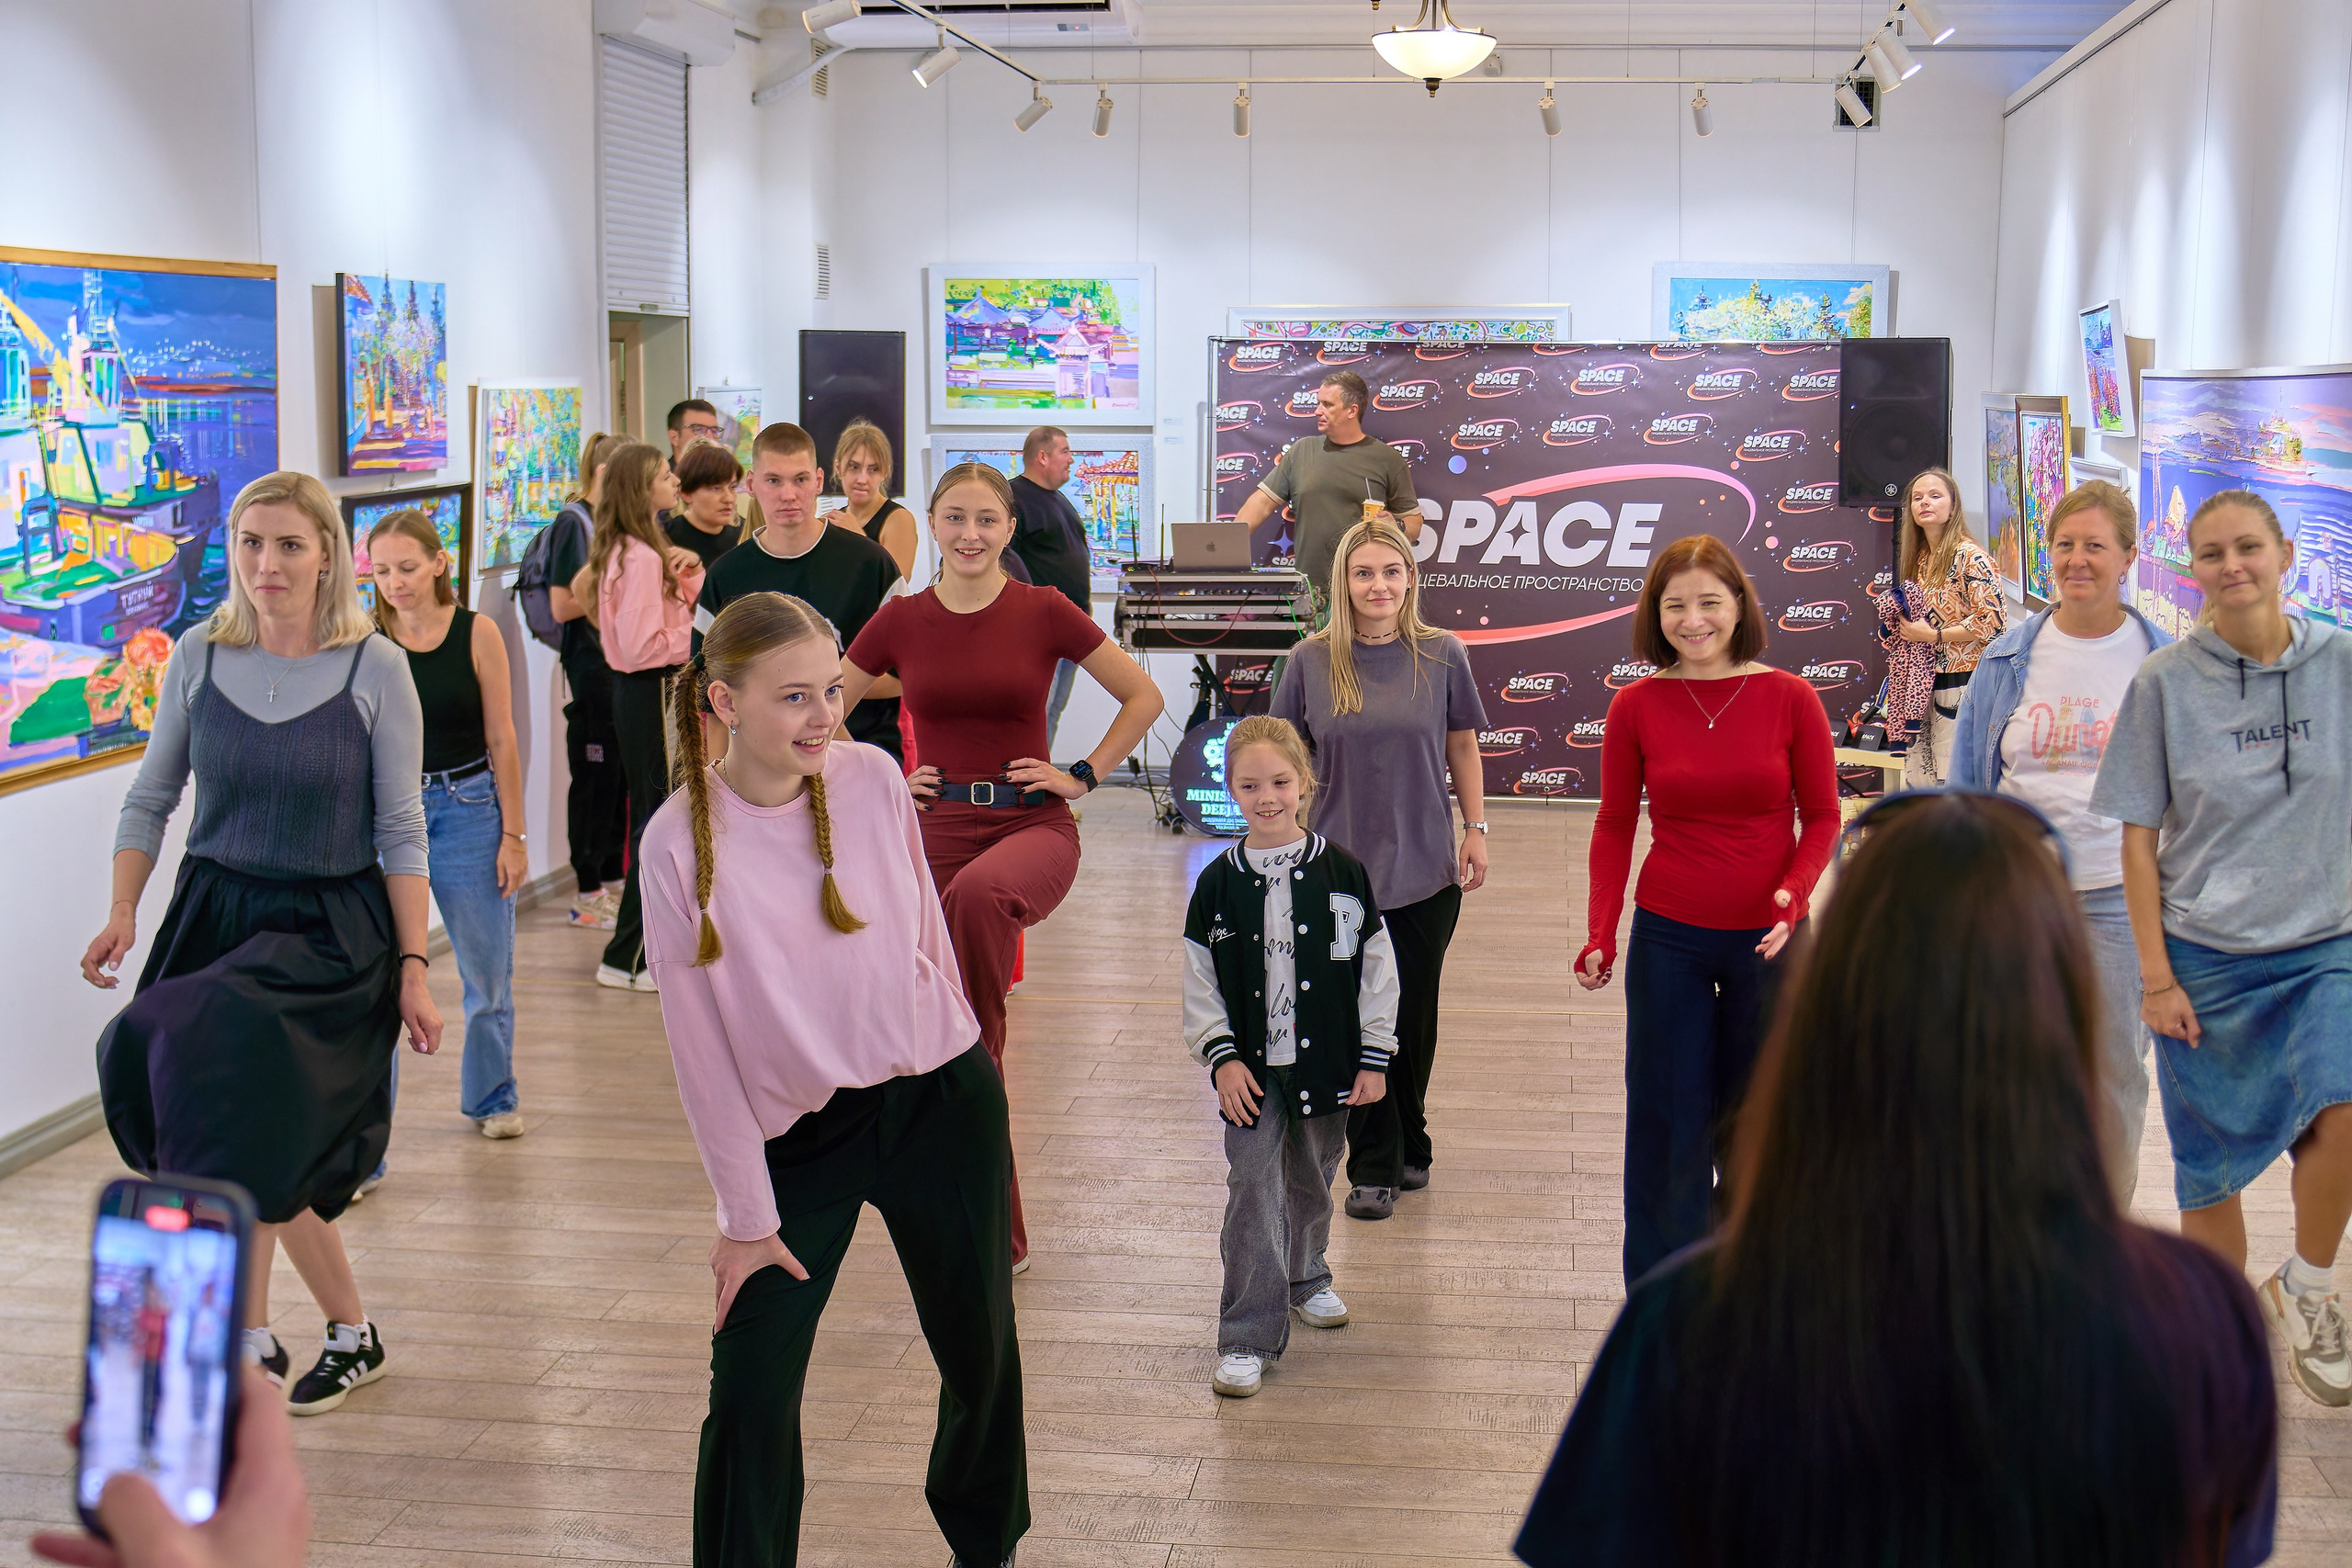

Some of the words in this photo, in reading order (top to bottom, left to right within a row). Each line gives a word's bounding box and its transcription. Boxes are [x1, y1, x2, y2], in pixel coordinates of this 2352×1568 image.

[1236, 345, 1282, 358] SPACE
[1474, 372, 1521, 385] SPACE
[1577, 369, 1625, 382] SPACE
[1694, 374, 1742, 388] SPACE
[1789, 375, 1838, 388] SPACE
[1292, 391, 1317, 404] SPA
[1380, 385, 1425, 398] SPACE
[1216, 406, 1249, 419] PACE
[1457, 423, 1504, 436] SPACE
[1550, 420, 1597, 433] SPACE
[1651, 419, 1698, 432] SPACE
[1743, 435, 1791, 448] SPACE
[1216, 458, 1244, 471] ACE
[1785, 487, 1833, 501] SPACE
[1790, 546, 1838, 559] SPACE
[1419, 573, 1511, 589] ЦЕВАЛЬНОЕ
[1513, 576, 1645, 592] ПРОСТРАНСТВО
[1785, 605, 1833, 619] SPACE
[1801, 665, 1848, 679] SPACE
[1508, 677, 1554, 691] SPACE
[2060, 696, 2099, 708] PLAGE
[1478, 731, 1523, 744] SPACE
[2230, 719, 2311, 753] TALENT
[1521, 772, 1566, 784] SPACE
[1186, 789, 1231, 802] MINIS
[1201, 803, 1243, 817] DEEJA
